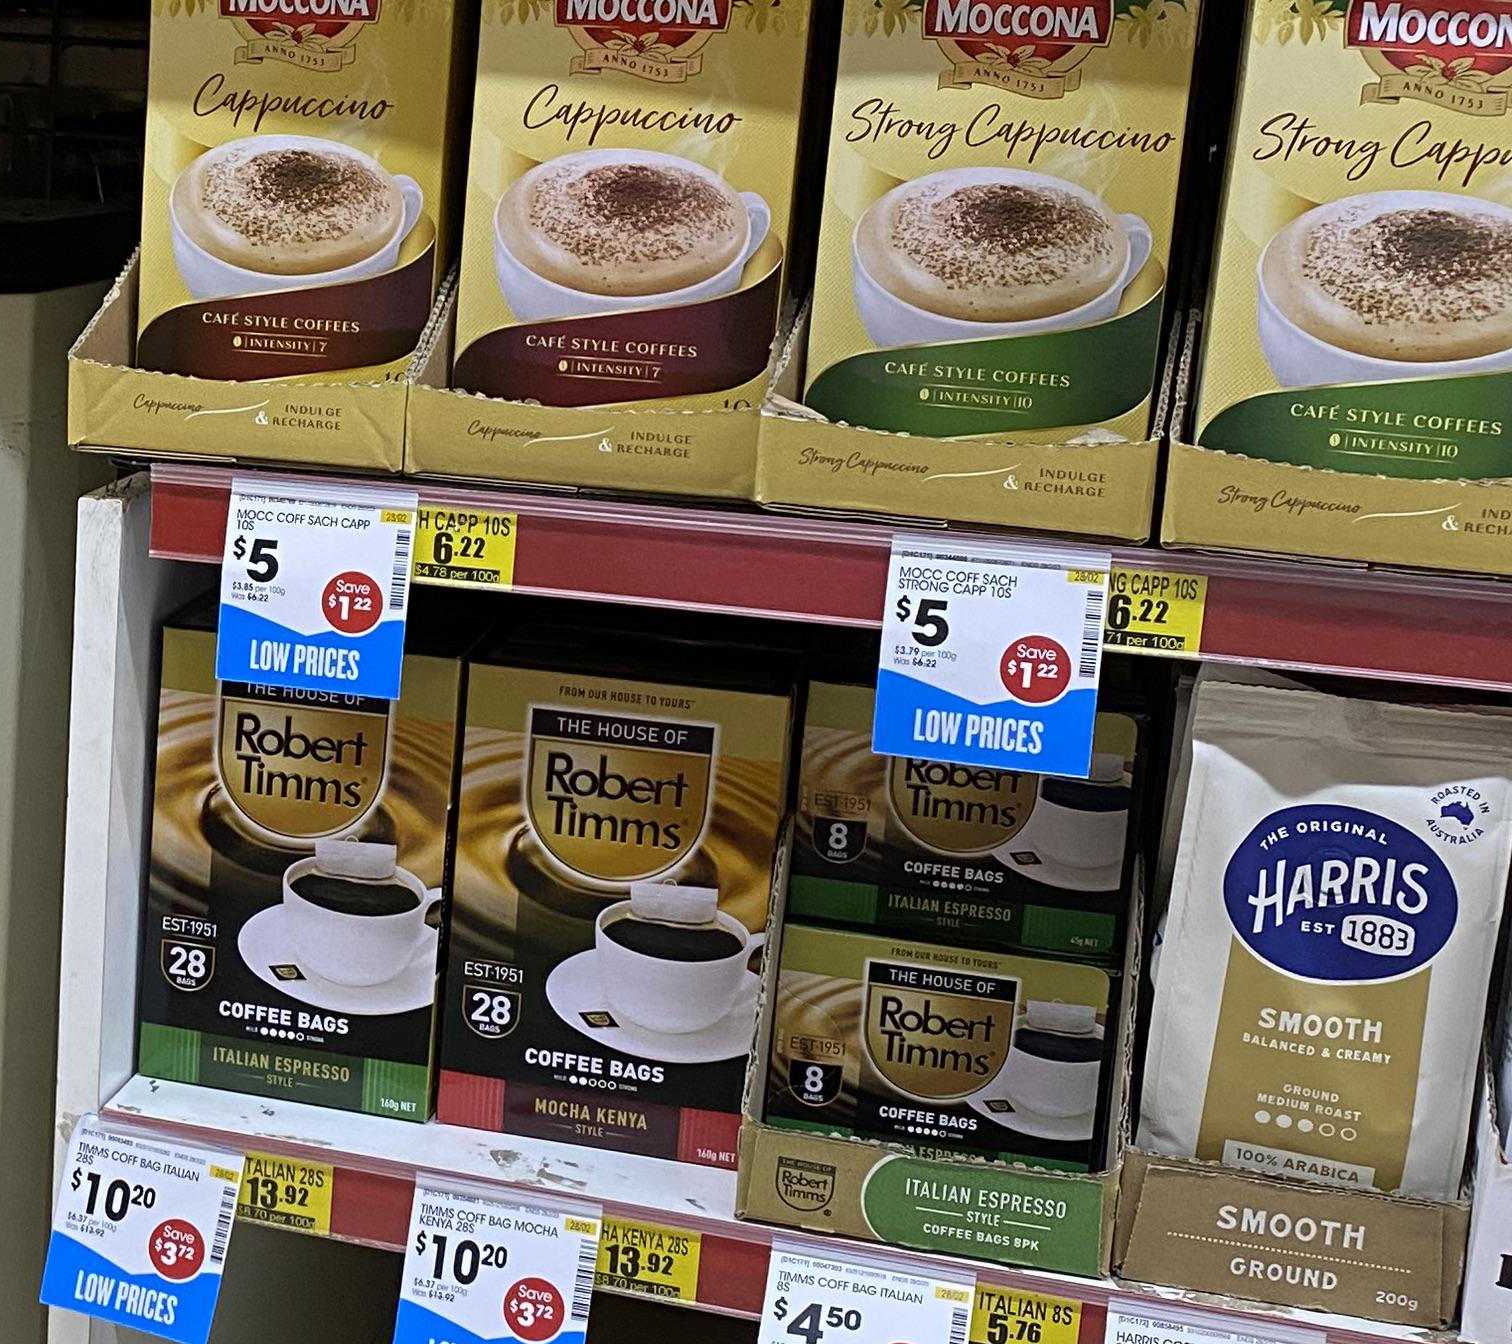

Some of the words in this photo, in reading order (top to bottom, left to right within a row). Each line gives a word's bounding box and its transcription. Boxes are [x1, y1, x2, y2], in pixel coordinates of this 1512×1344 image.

[845, 98, 962, 160] Strong
[965, 104, 1177, 163] Cappuccino
[434, 532, 485, 565] 6.22
[896, 595, 950, 648] $5
[1016, 644, 1057, 661] Save
[557, 716, 592, 734] THE
[598, 721, 659, 743] HOUSE
[664, 728, 688, 745] OF
[545, 751, 688, 808] Robert
[547, 795, 681, 851] Timms
[1248, 856, 1429, 934] HARRIS
[168, 947, 206, 978] 28
[1258, 1007, 1384, 1044] SMOOTH
[524, 1047, 604, 1075] COFFEE
[610, 1060, 665, 1084] BAGS
[1242, 1032, 1315, 1058] BALANCED
[1321, 1047, 1331, 1059] &
[1336, 1048, 1392, 1065] CREAMY
[534, 1096, 591, 1122] MOCHA
[596, 1105, 648, 1131] KENYA
[905, 1177, 975, 1207] ITALIAN
[978, 1189, 1067, 1219] ESPRESSO
[419, 1215, 453, 1231] KENYA
[455, 1221, 475, 1234] 28S
[421, 1203, 456, 1220] TIMMS
[457, 1209, 486, 1225] COFF
[488, 1216, 512, 1230] BAG
[514, 1220, 559, 1239] MOCHA
[74, 1269, 113, 1304] LOW
[116, 1281, 178, 1326] PRICES
[1375, 1291, 1419, 1311] 200g
